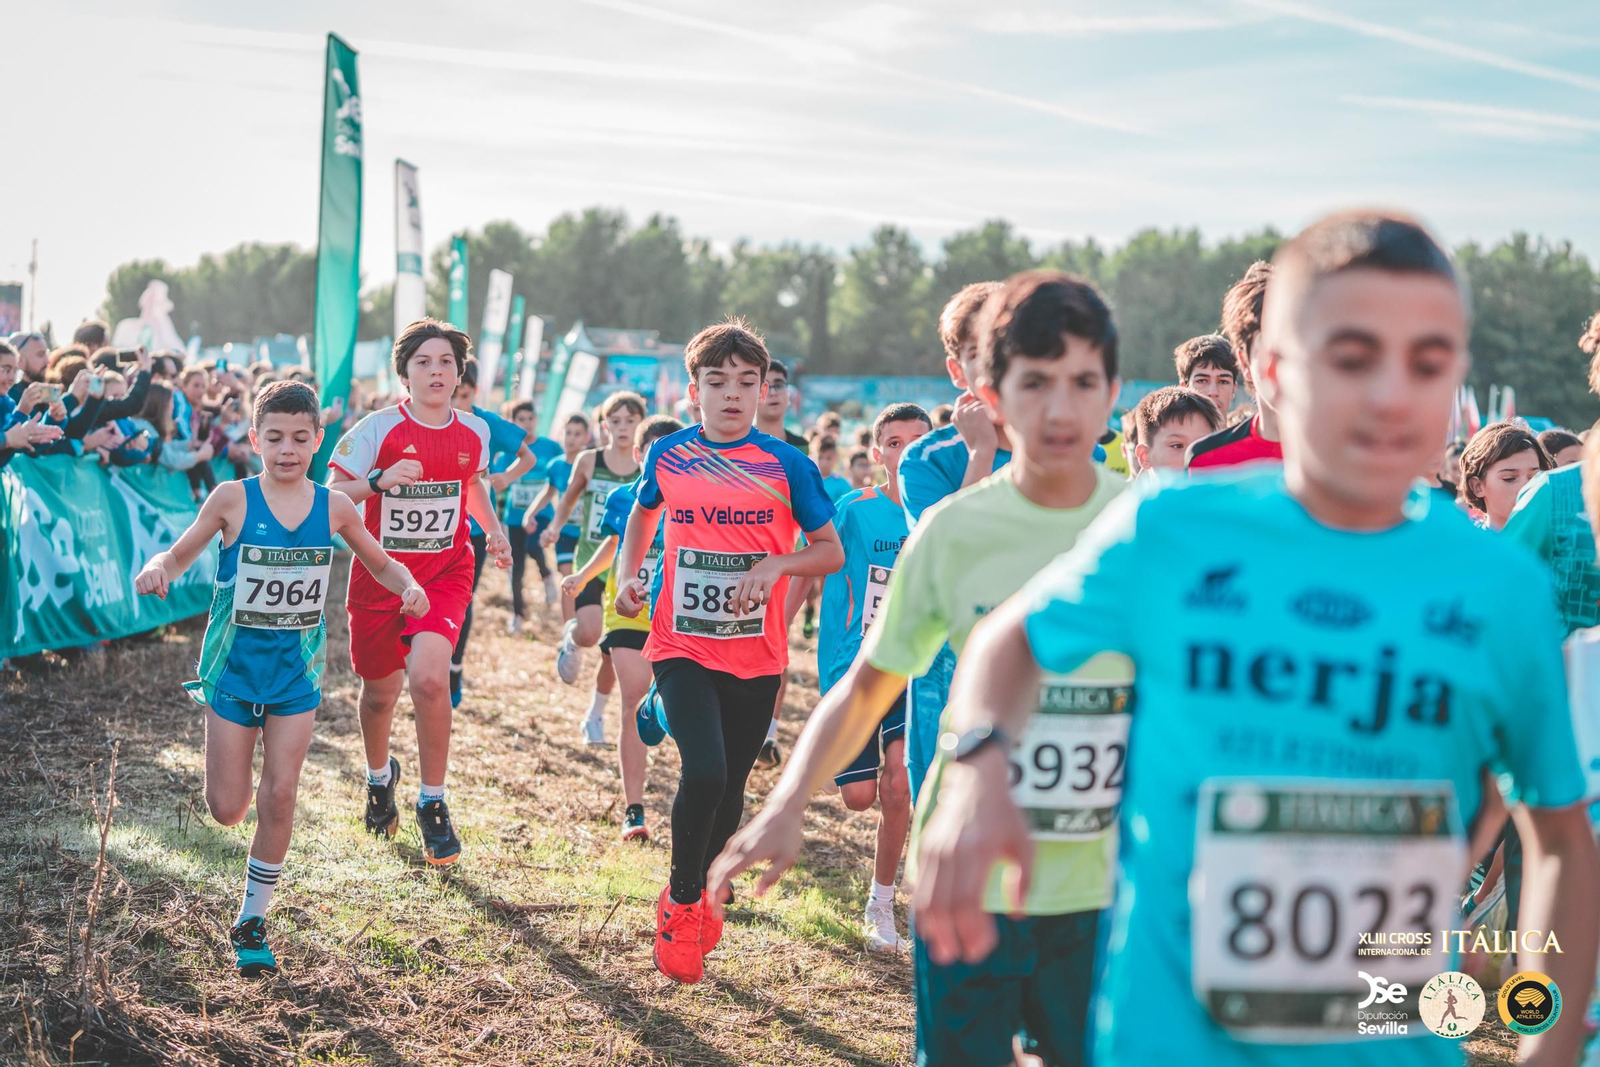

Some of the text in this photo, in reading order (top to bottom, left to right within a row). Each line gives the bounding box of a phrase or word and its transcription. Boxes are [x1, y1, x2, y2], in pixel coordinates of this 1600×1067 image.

[389, 508, 455, 532] 5927
[701, 506, 774, 525] Veloces
[267, 549, 309, 561] ITÁLICA
[702, 554, 745, 567] ITÁLICA
[245, 577, 322, 606] 7964
[682, 582, 760, 614] 588
[1186, 639, 1453, 735] nerja
[1228, 883, 1436, 963] 8023
